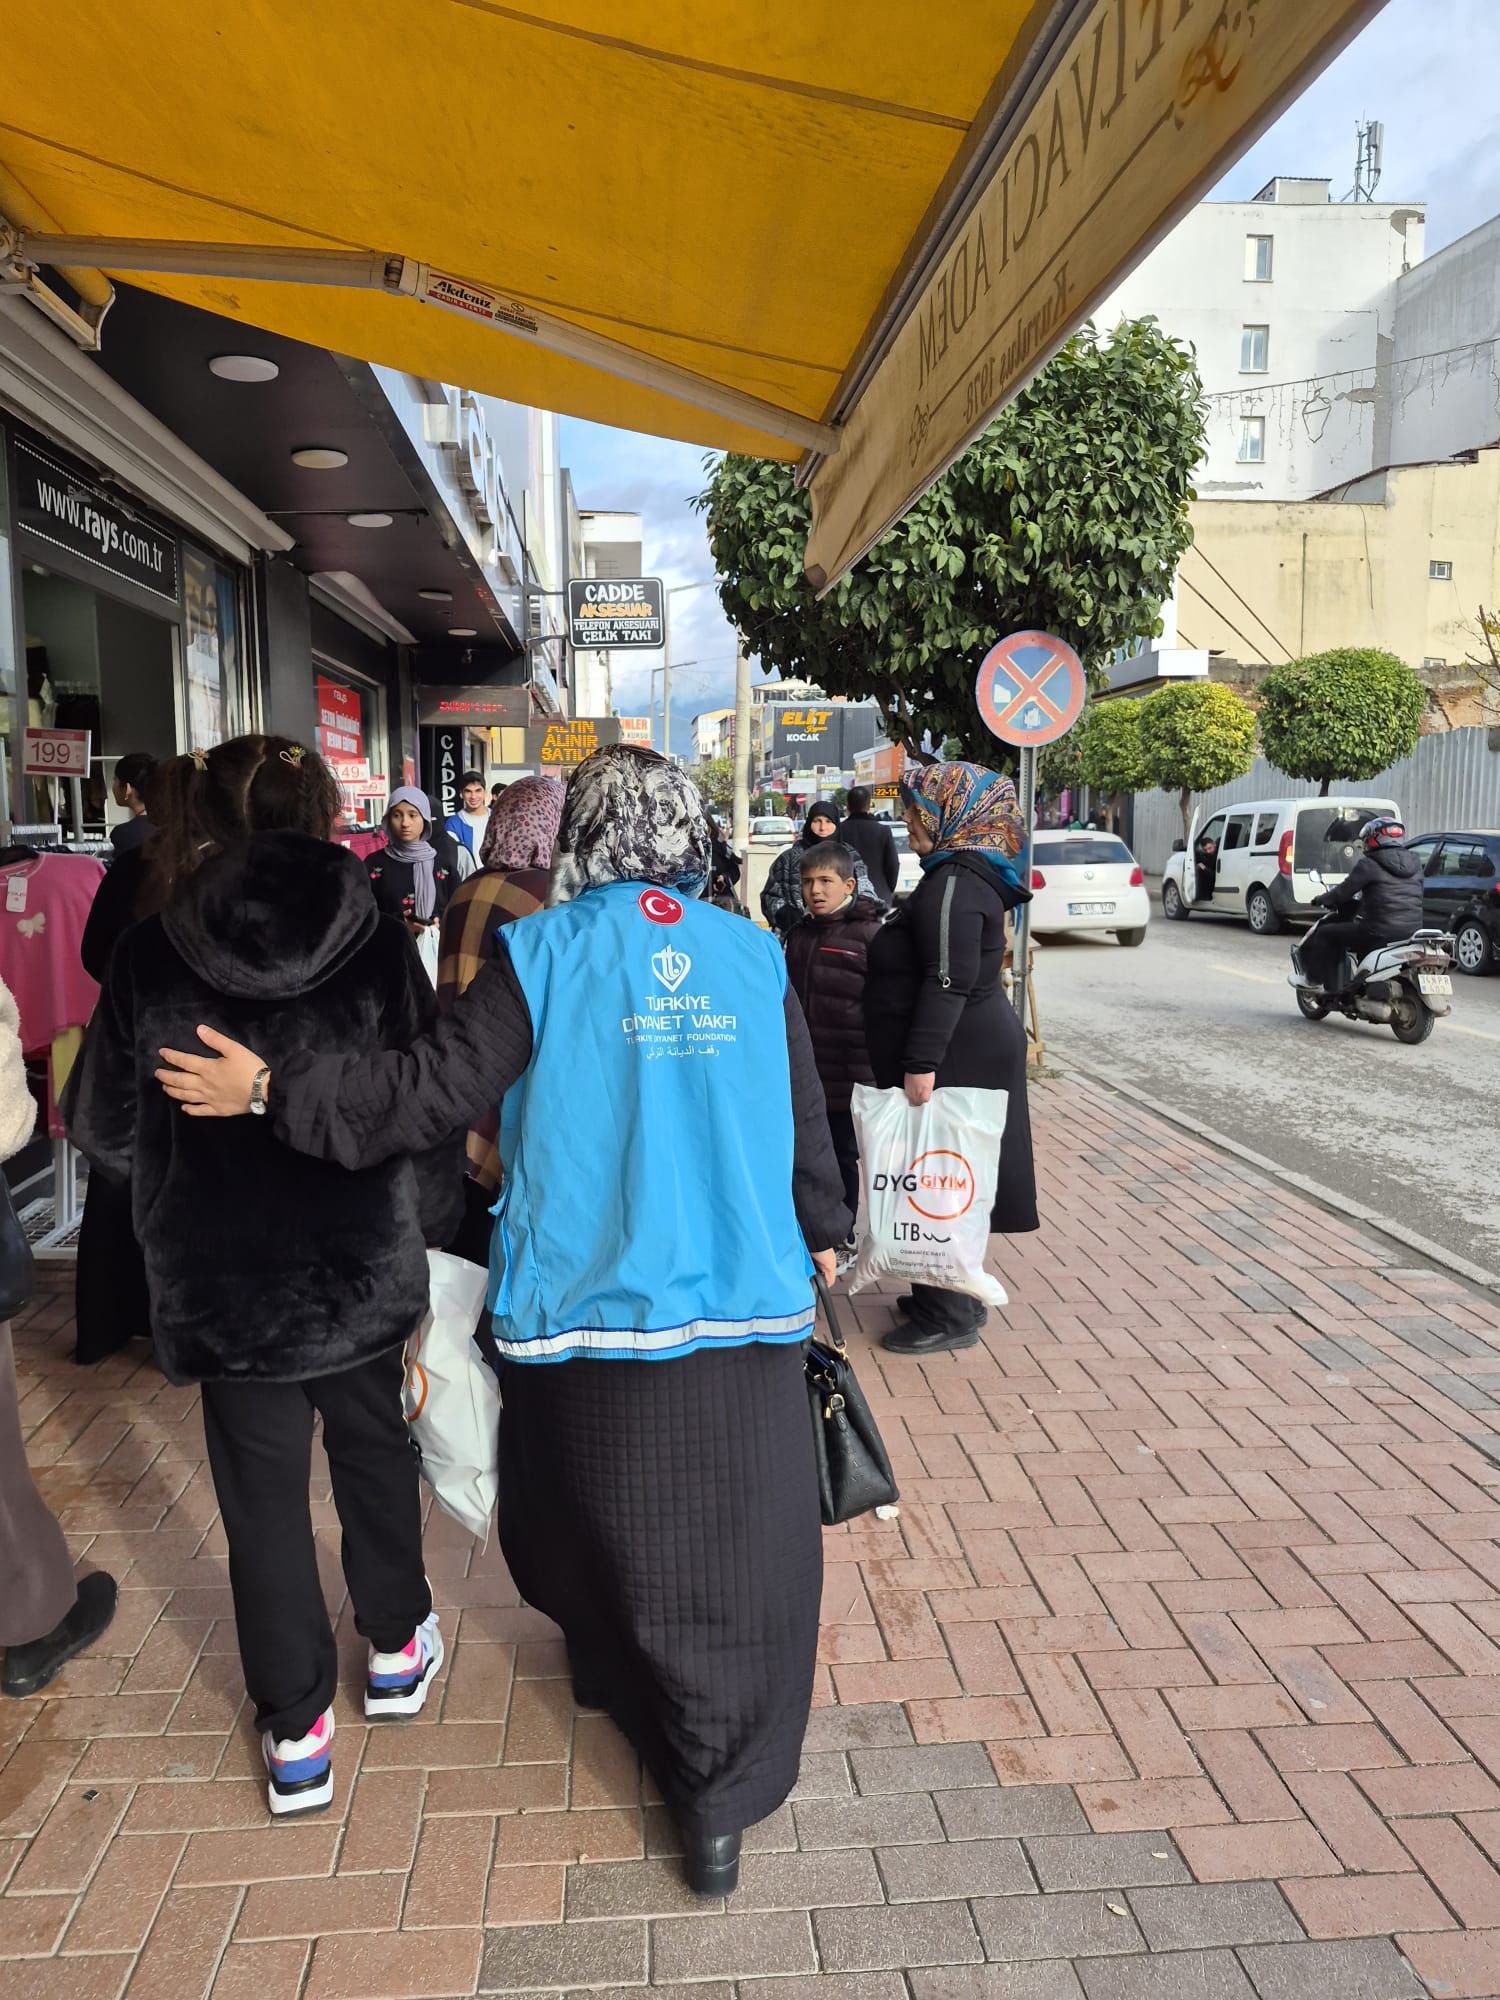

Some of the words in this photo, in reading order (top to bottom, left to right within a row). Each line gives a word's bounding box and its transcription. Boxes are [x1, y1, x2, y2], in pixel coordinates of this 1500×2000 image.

[37, 479, 163, 573] www.rays.com.tr
[584, 584, 646, 602] CADDE
[580, 602, 653, 618] AKSESUAR
[573, 620, 611, 631] TELEFON
[613, 618, 659, 630] AKSESUARI
[582, 630, 619, 644] ÇELİK
[622, 629, 652, 641] TAKI
[781, 707, 833, 726] ELİT
[32, 741, 70, 764] 199
[440, 734, 457, 818] CADDE
[645, 994, 712, 1012] TÜRKİYE
[622, 1013, 684, 1033] DİYANET
[691, 1014, 737, 1030] VAKFI
[686, 1033, 737, 1042] FOUNDATION
[873, 1174, 917, 1192] DYG
[920, 1174, 967, 1189] GİYİM
[893, 1222, 920, 1241] LTB
